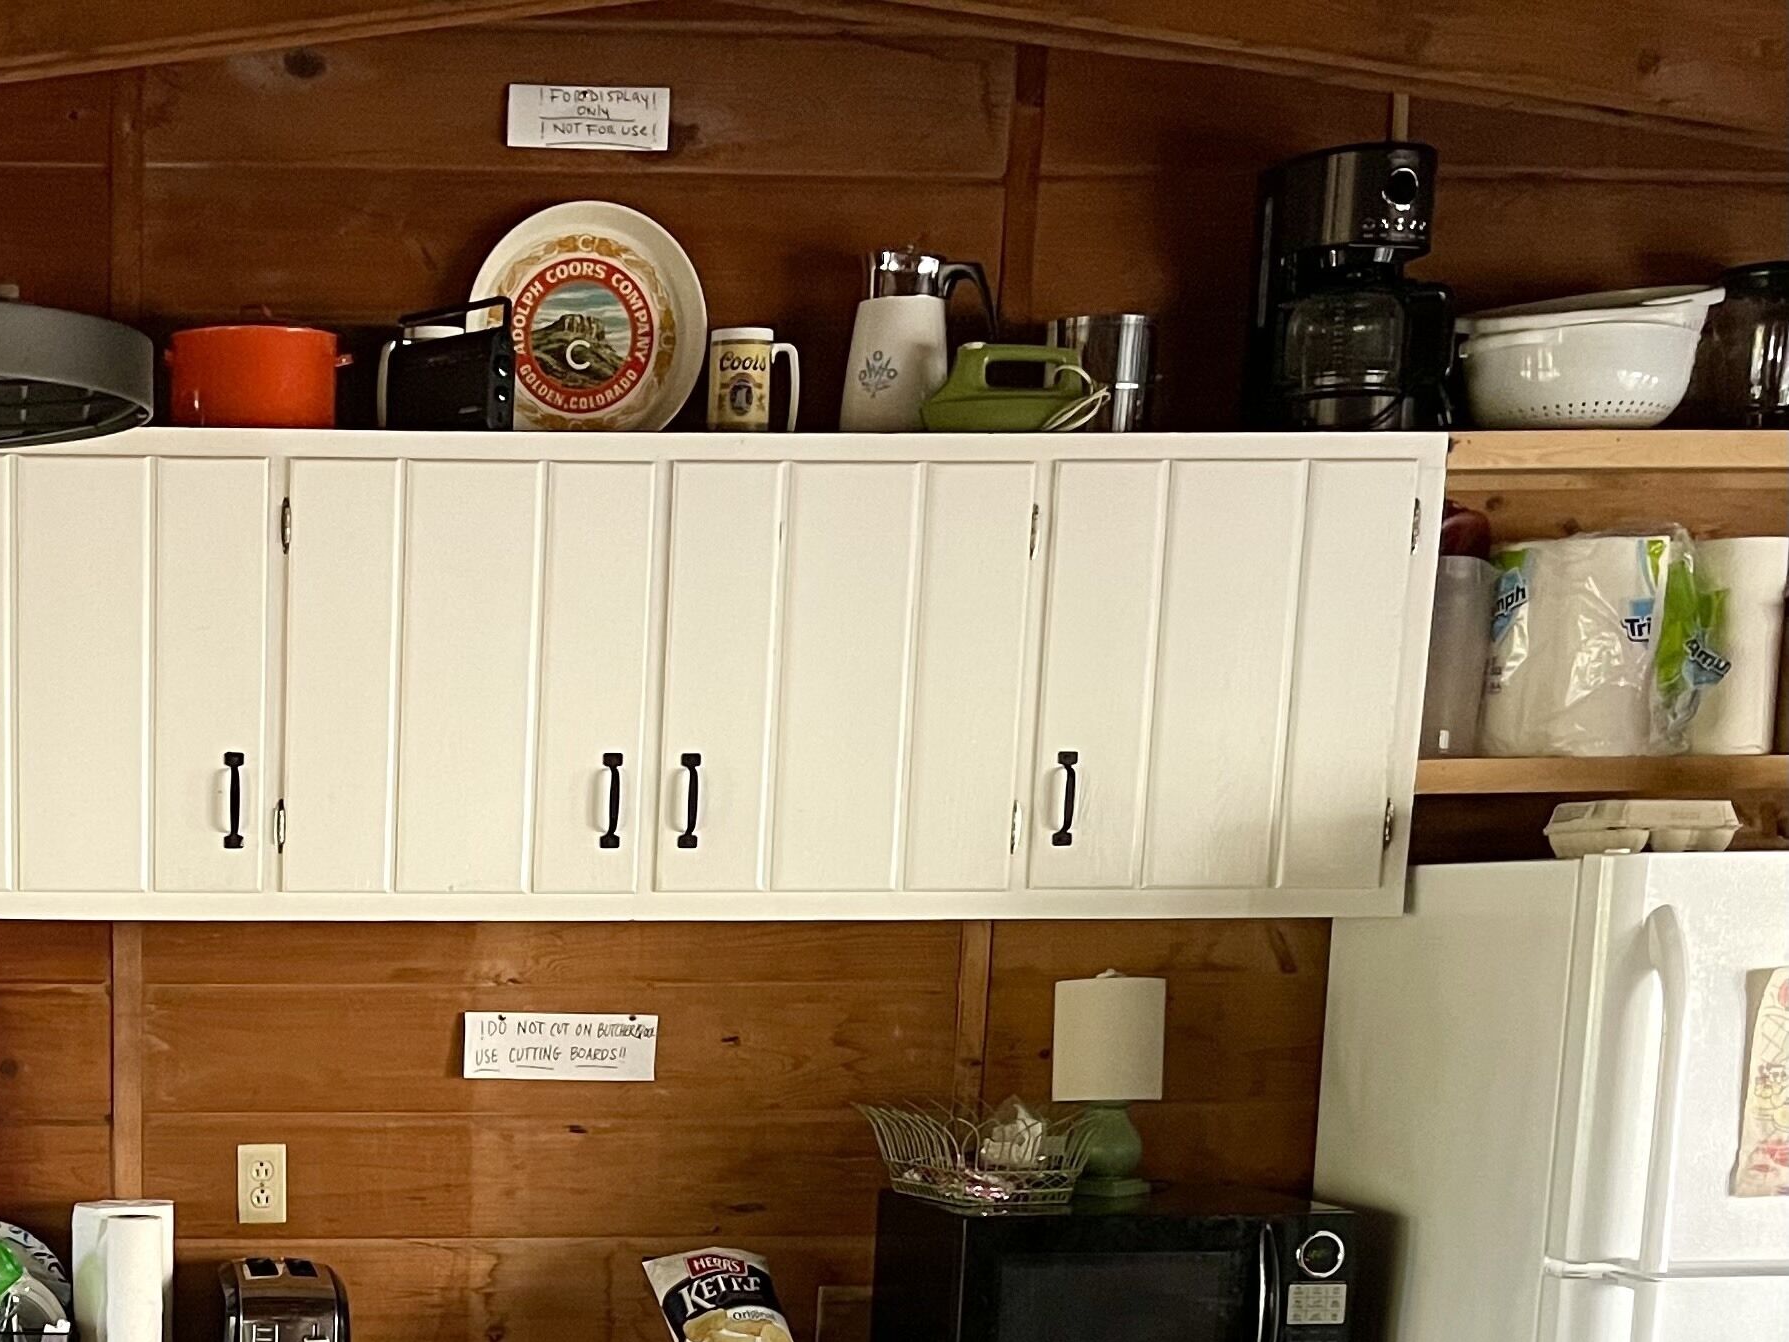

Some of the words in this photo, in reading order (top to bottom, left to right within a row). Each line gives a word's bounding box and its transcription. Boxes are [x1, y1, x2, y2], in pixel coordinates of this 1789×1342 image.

[553, 123, 581, 136] NOT
[586, 124, 616, 136] FOR
[512, 280, 545, 355] ADOLPH
[545, 261, 607, 284] COORS
[611, 273, 654, 364] COMPANY
[570, 368, 639, 410] COLORADO
[517, 1020, 545, 1037] NOT
[550, 1022, 569, 1037] CUT
[575, 1023, 592, 1037] ON
[475, 1048, 498, 1066] USE
[509, 1045, 562, 1063] CUTTING
